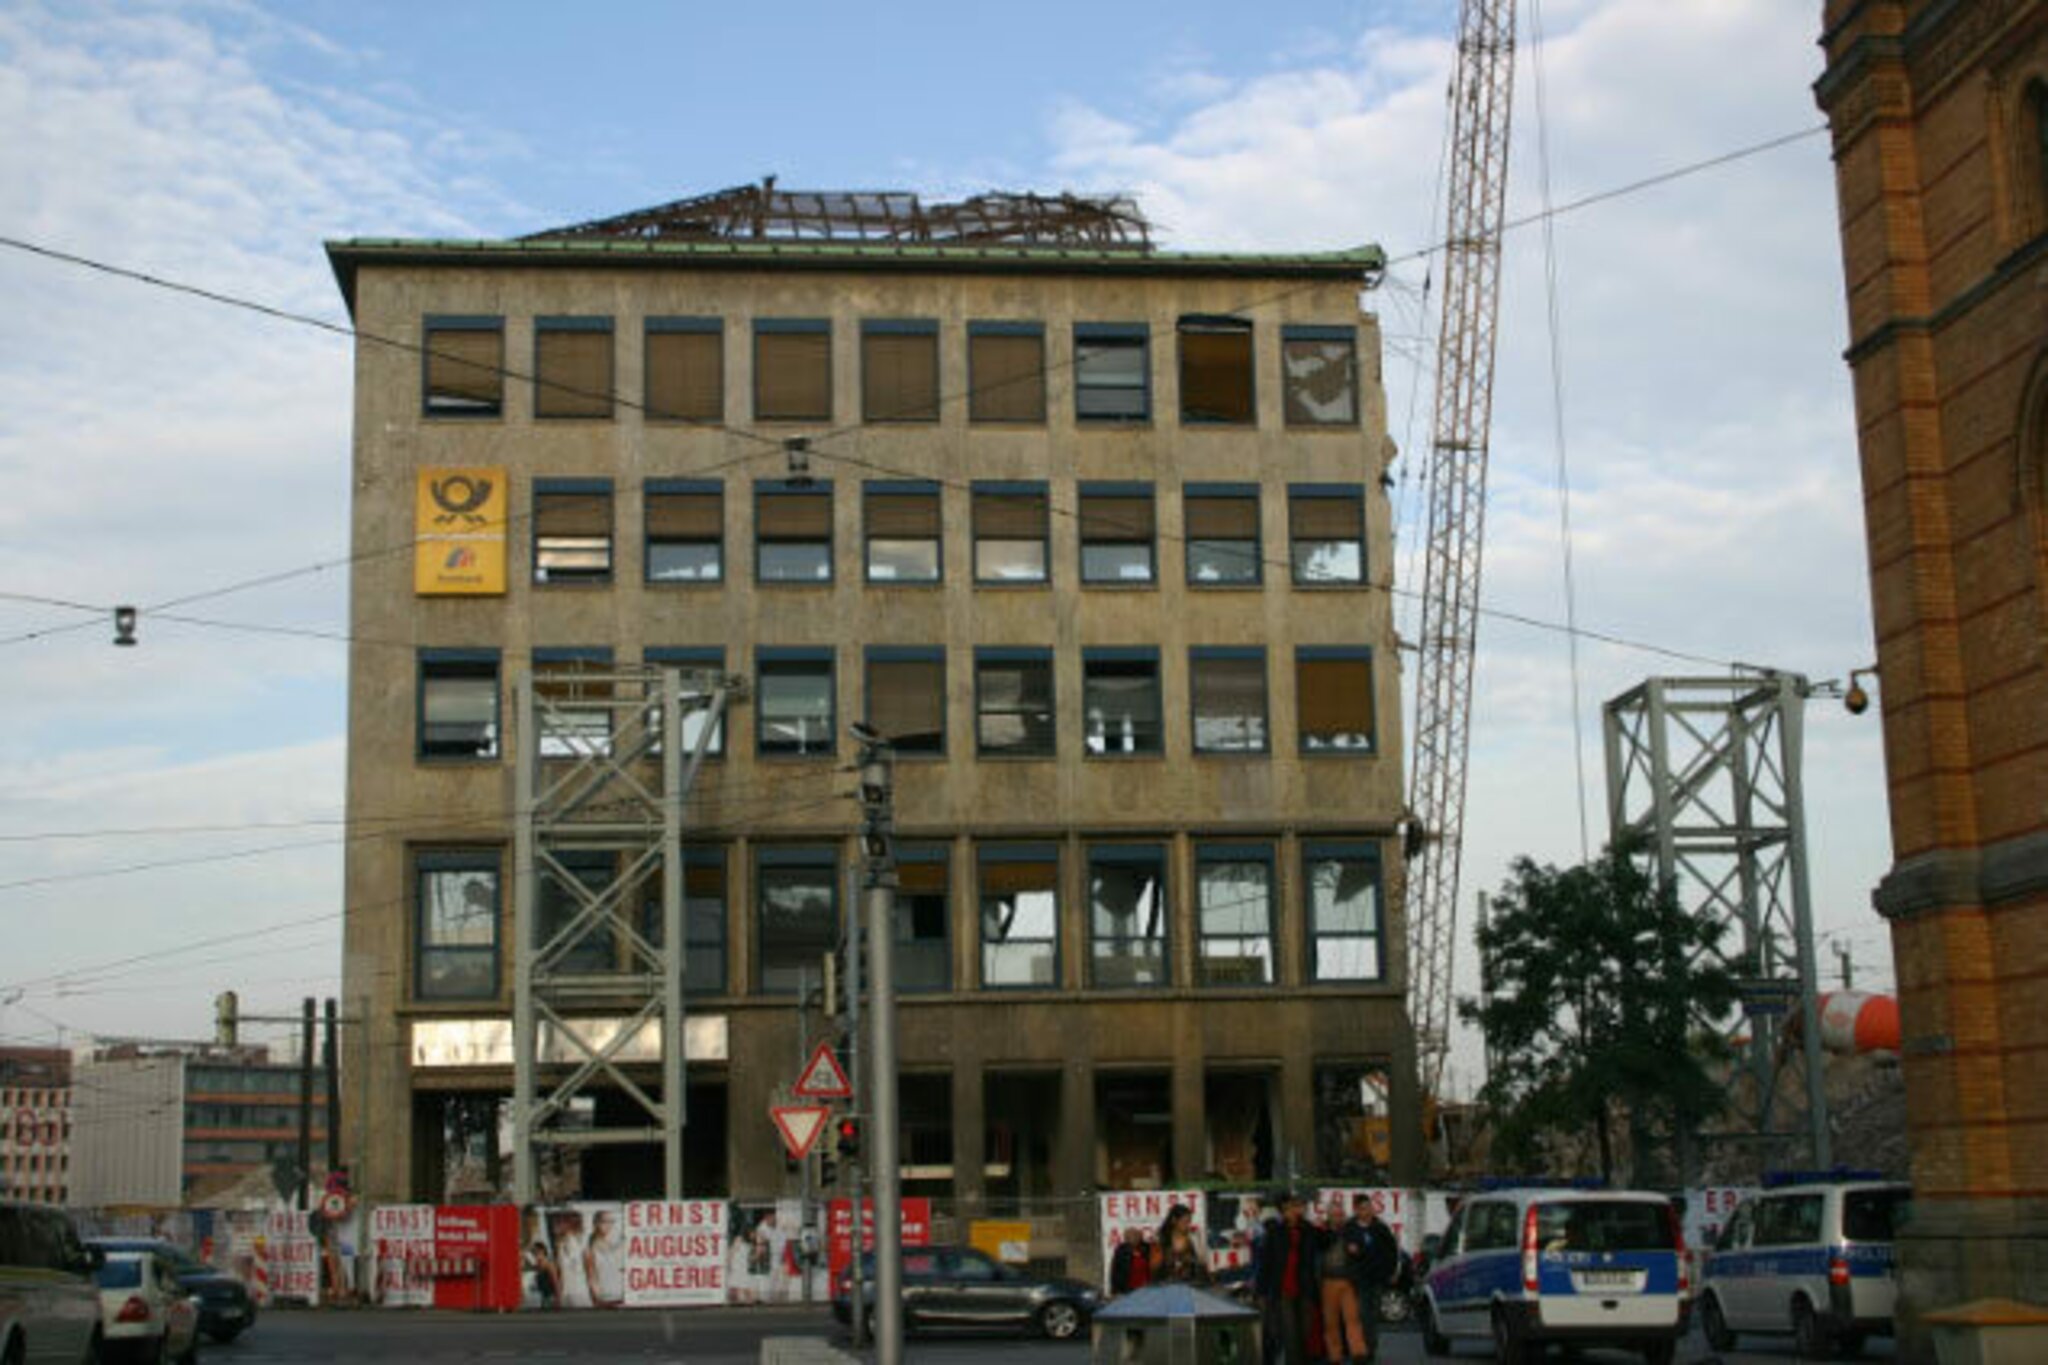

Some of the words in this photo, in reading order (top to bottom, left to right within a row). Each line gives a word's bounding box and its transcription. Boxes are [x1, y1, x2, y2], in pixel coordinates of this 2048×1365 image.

[628, 1202, 721, 1227] ERNST
[628, 1234, 721, 1259] AUGUST
[628, 1265, 722, 1291] GALERIE
